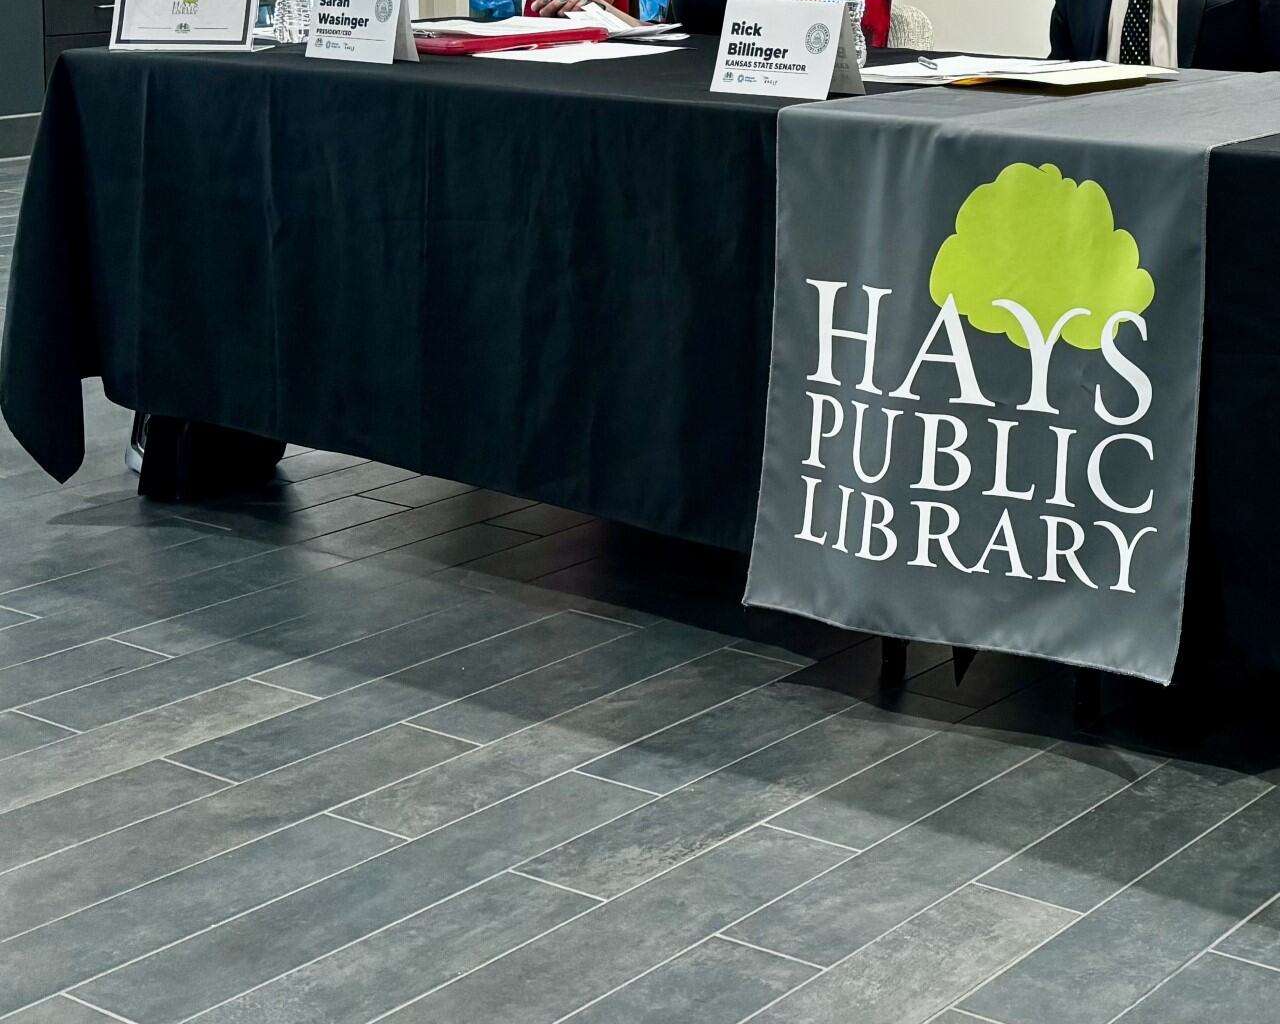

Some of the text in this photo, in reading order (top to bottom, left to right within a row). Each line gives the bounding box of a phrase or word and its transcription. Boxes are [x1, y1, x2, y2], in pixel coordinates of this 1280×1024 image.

[318, 13, 369, 29] Wasinger
[731, 20, 762, 37] Rick
[316, 28, 352, 36] PRESIDENT/CEO
[728, 42, 788, 60] Billinger
[725, 59, 807, 72] KANSAS STATE SENATOR
[806, 278, 1153, 426] HAYS
[800, 390, 1155, 515] PUBLIC
[793, 474, 1158, 594] LIBRARY
